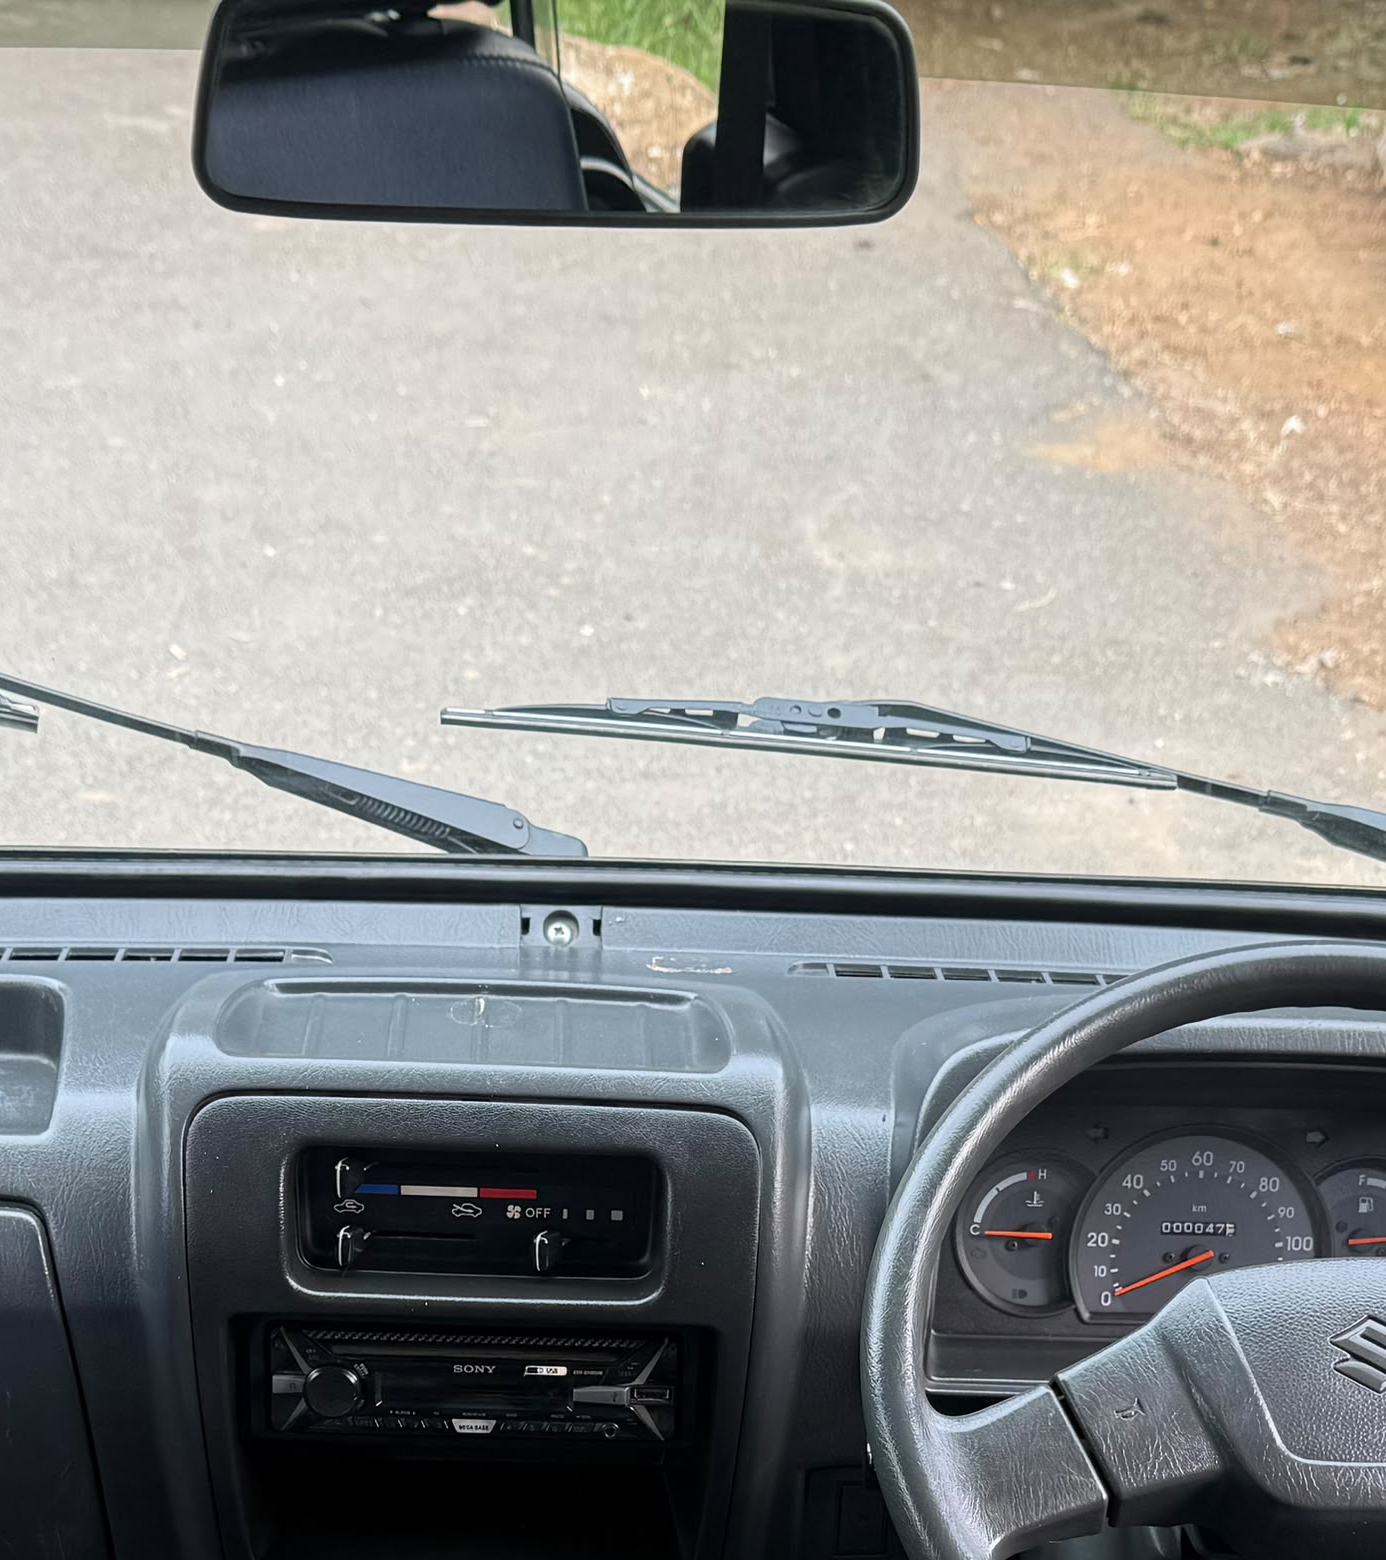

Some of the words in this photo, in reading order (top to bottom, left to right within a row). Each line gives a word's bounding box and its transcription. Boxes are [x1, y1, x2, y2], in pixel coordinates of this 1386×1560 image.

[1159, 1159, 1177, 1172] 50
[1191, 1150, 1214, 1167] 60
[1037, 1168, 1047, 1180] H
[1229, 1160, 1246, 1174] 70
[1121, 1173, 1144, 1190] 40
[1258, 1176, 1280, 1193] 80
[1358, 1174, 1367, 1186] F
[524, 1207, 552, 1219] OFF
[1103, 1203, 1122, 1217] 30
[1191, 1204, 1207, 1213] km
[1277, 1206, 1295, 1219] 90
[969, 1223, 981, 1236] C
[1086, 1231, 1109, 1248] 20
[1285, 1235, 1314, 1252] 100
[1093, 1264, 1107, 1278] 10
[1100, 1290, 1112, 1307] 0
[453, 1364, 496, 1374] SONY
